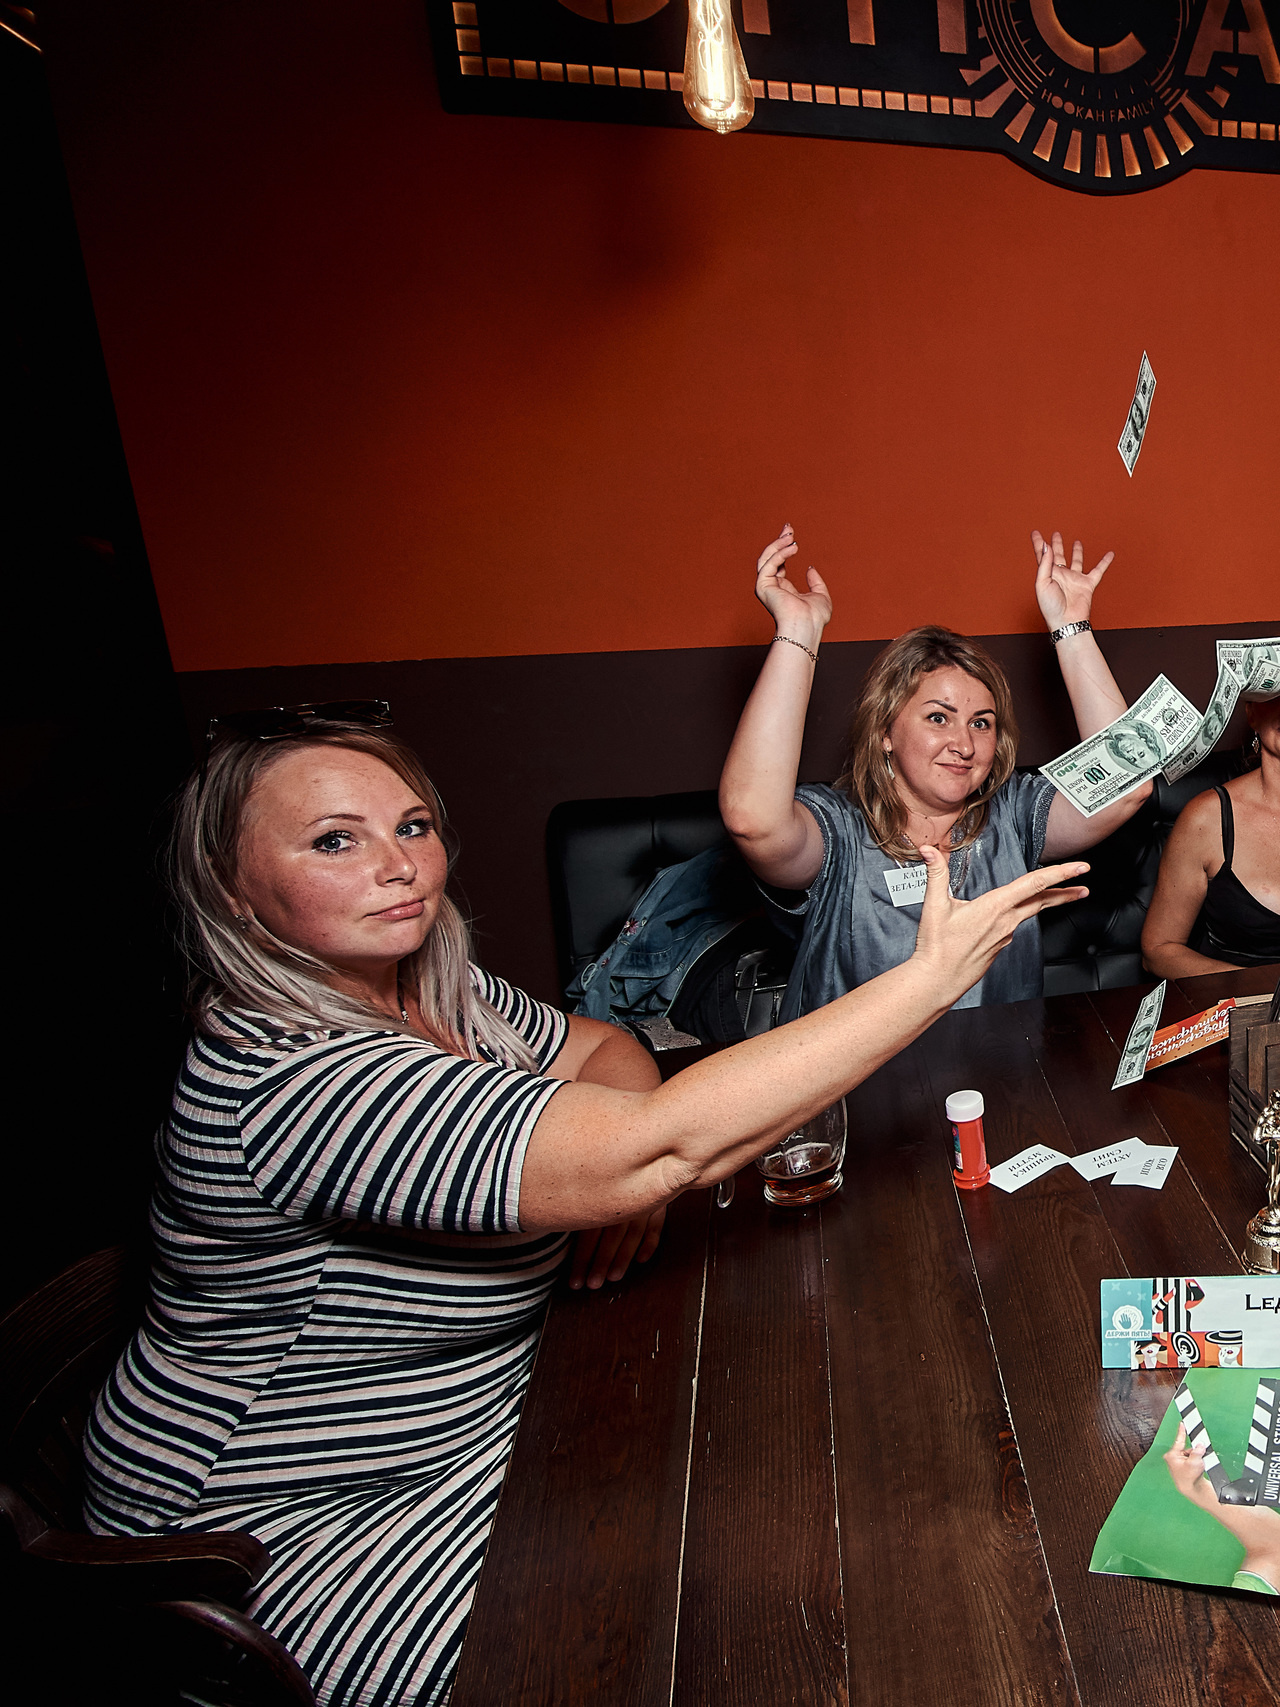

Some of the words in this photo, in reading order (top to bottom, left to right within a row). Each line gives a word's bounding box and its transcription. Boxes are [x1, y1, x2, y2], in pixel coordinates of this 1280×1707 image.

[1041, 88, 1104, 122] HOOKAH
[1110, 98, 1156, 122] FAMILY
[1259, 679, 1274, 691] 100
[1057, 761, 1078, 778] 100
[1084, 763, 1112, 785] 100
[1076, 785, 1088, 794] PLAY
[903, 870, 927, 880] КАТЬ
[891, 879, 927, 893] ЗЕТА-ДЖ
[1151, 1006, 1233, 1051] ертифика
[1008, 1151, 1042, 1172] МУТТИ
[1092, 1149, 1122, 1164] СМИТ
[1097, 1152, 1132, 1169] АХТЕМ
[1013, 1154, 1056, 1178] ИРИШКА
